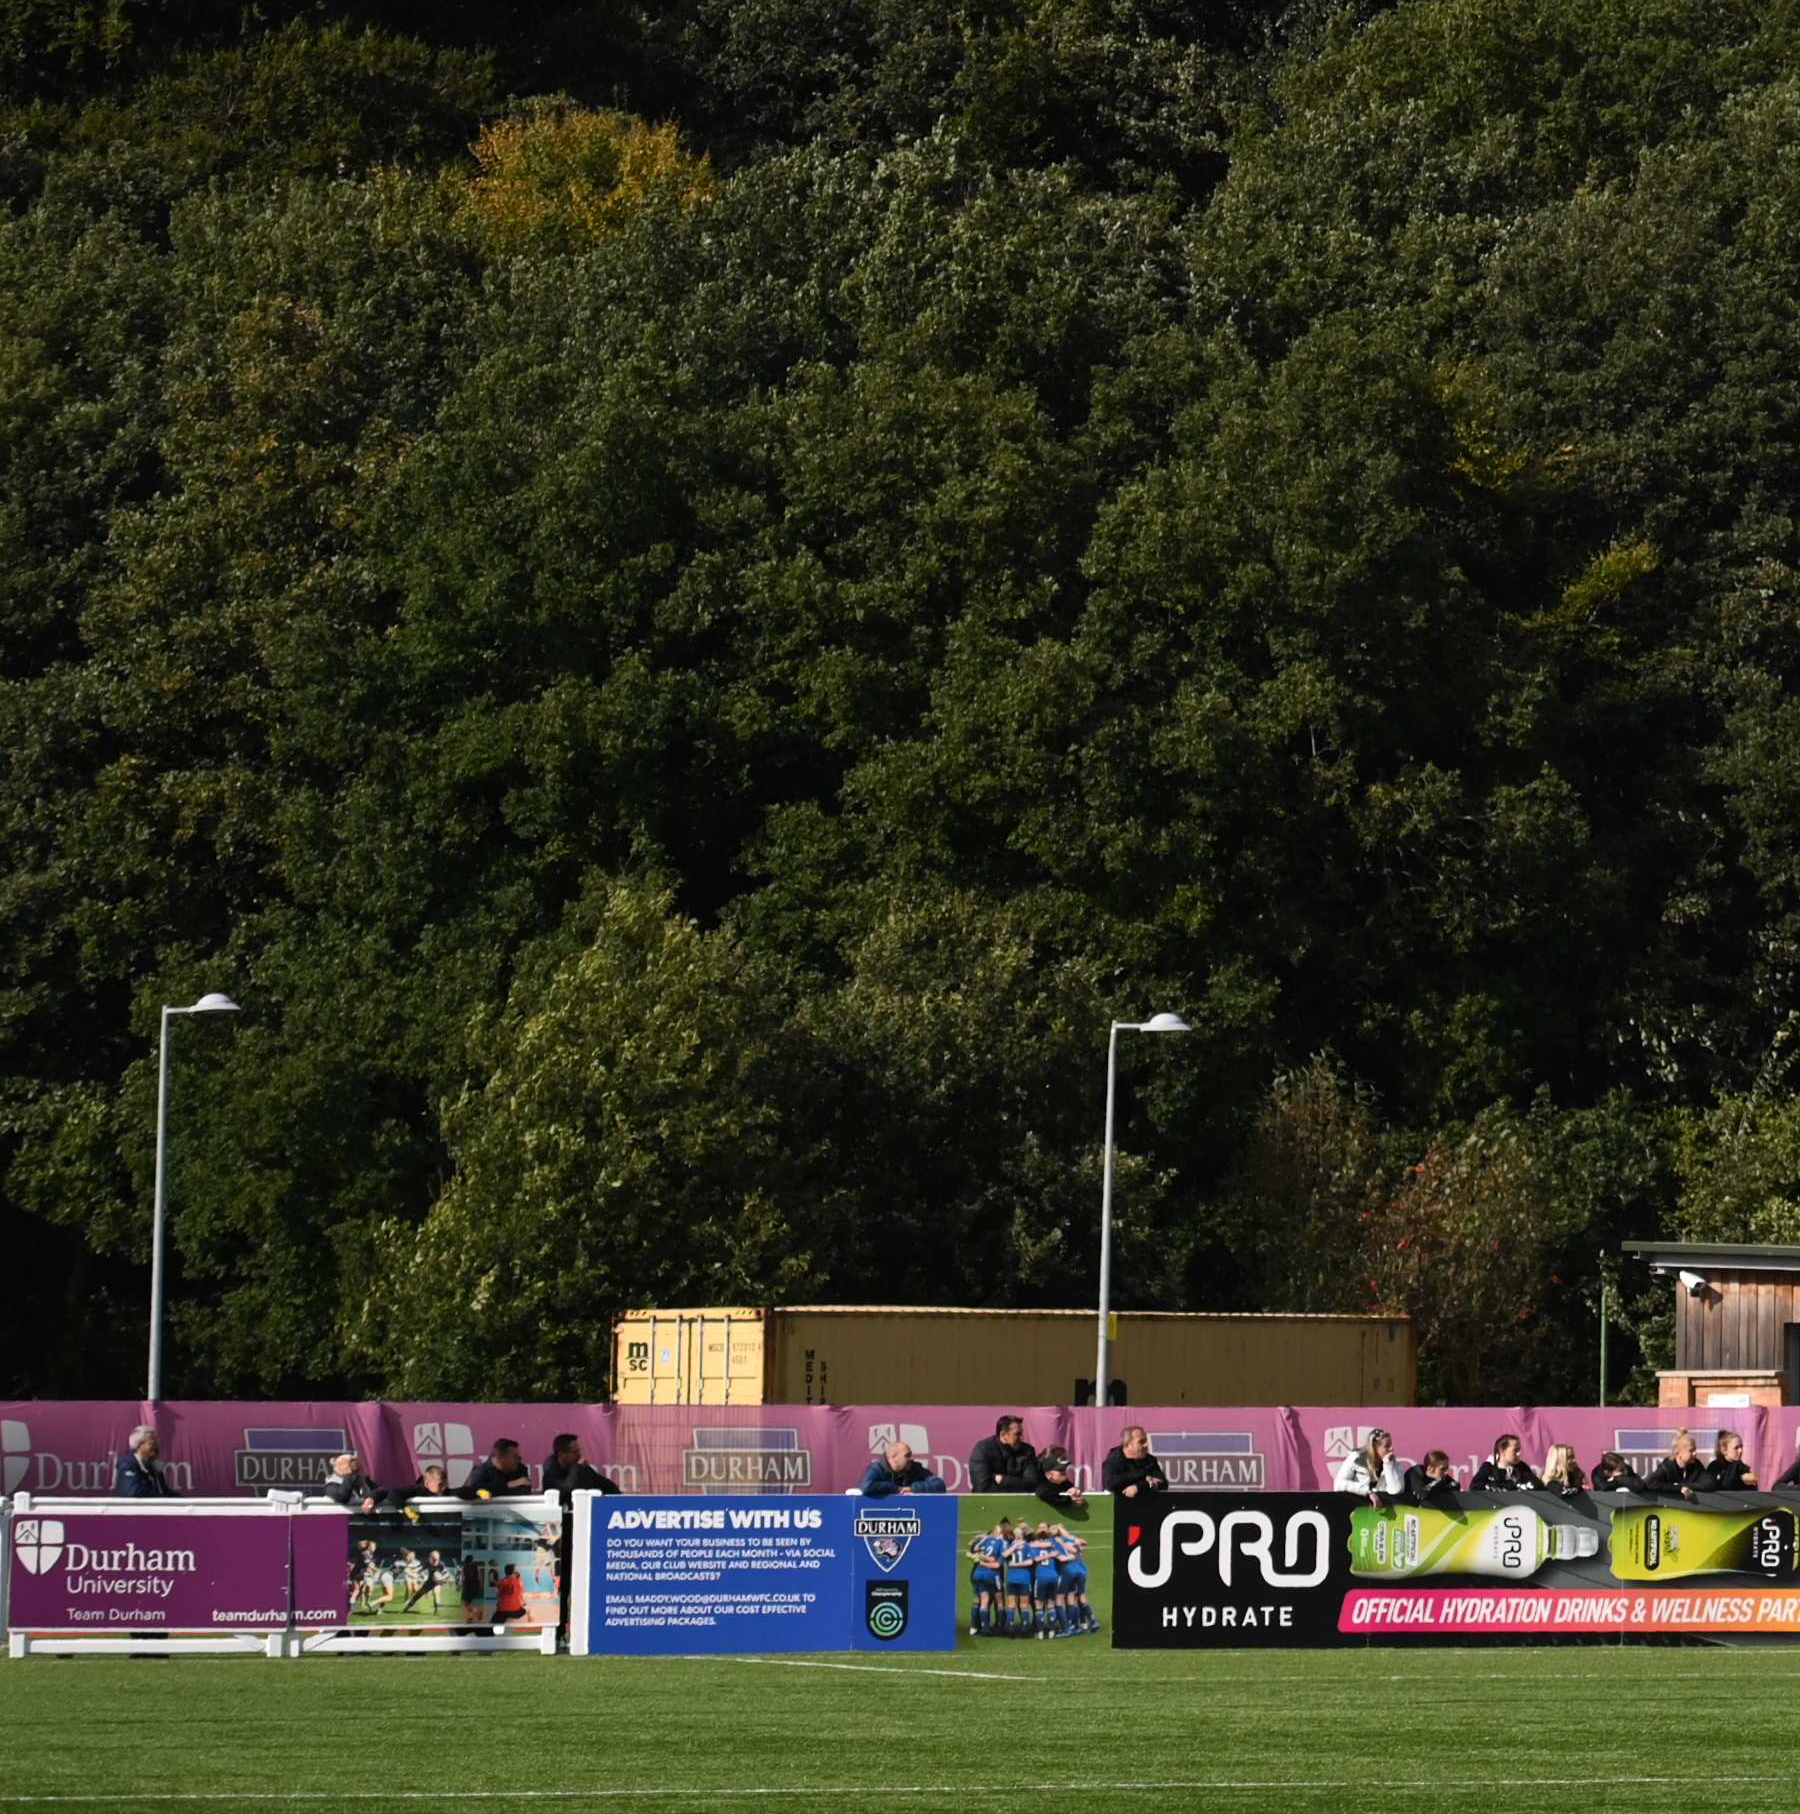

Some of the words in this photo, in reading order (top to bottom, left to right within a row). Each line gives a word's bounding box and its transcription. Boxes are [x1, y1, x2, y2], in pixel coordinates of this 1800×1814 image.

[34, 1450, 195, 1490] Durm
[242, 1456, 338, 1481] DURHA
[690, 1456, 803, 1481] DURHAM
[1163, 1459, 1257, 1483] URHAM
[607, 1510, 725, 1529] ADVERTISE
[729, 1510, 790, 1529] WITH
[793, 1509, 822, 1529] US
[858, 1521, 917, 1534] DURHAM
[607, 1538, 622, 1548] DO
[624, 1538, 643, 1547] YOU
[645, 1538, 674, 1547] WANT
[675, 1538, 701, 1547] YOUR
[702, 1538, 746, 1547] BUSINESS
[747, 1538, 760, 1546] TO
[762, 1538, 774, 1546] BE
[775, 1538, 798, 1547] SEEN
[800, 1537, 812, 1546] BY
[65, 1543, 196, 1572] Durham
[606, 1549, 664, 1559] THOUSANDS
[665, 1549, 679, 1558] OF
[680, 1549, 714, 1558] PEOPLE
[715, 1549, 740, 1558] EACH
[741, 1549, 778, 1558] MONTH
[785, 1549, 801, 1558] VIA
[803, 1548, 836, 1558] SOCIAL
[641, 1561, 662, 1570] OUR
[663, 1561, 686, 1570] CLUB
[688, 1561, 727, 1569] WEBSITE
[728, 1561, 749, 1569] AND
[750, 1560, 797, 1569] REGIONAL
[799, 1560, 821, 1569] AND
[606, 1572, 654, 1581] NATIONAL
[655, 1572, 721, 1581] BROADCASTS?
[66, 1575, 174, 1597] University
[605, 1594, 634, 1604] EMAIL
[802, 1593, 816, 1602] TO
[66, 1607, 105, 1621] Team
[108, 1607, 166, 1621] Durham
[605, 1606, 627, 1615] FIND
[628, 1606, 649, 1615] OUT
[650, 1606, 678, 1615] MORE
[679, 1605, 713, 1614] ABOUT
[714, 1605, 734, 1614] OUR
[735, 1605, 760, 1614] COST
[761, 1604, 807, 1614] EFFECTIVE
[1162, 1605, 1294, 1628] HYDRATE
[1352, 1597, 1436, 1624] OFFICIAL
[1440, 1597, 1551, 1624] HYDRATION
[1553, 1597, 1628, 1624] DRINKS
[1630, 1597, 1647, 1624] &
[1651, 1597, 1754, 1624] WELLNESS
[604, 1617, 666, 1626] ADVERTISING
